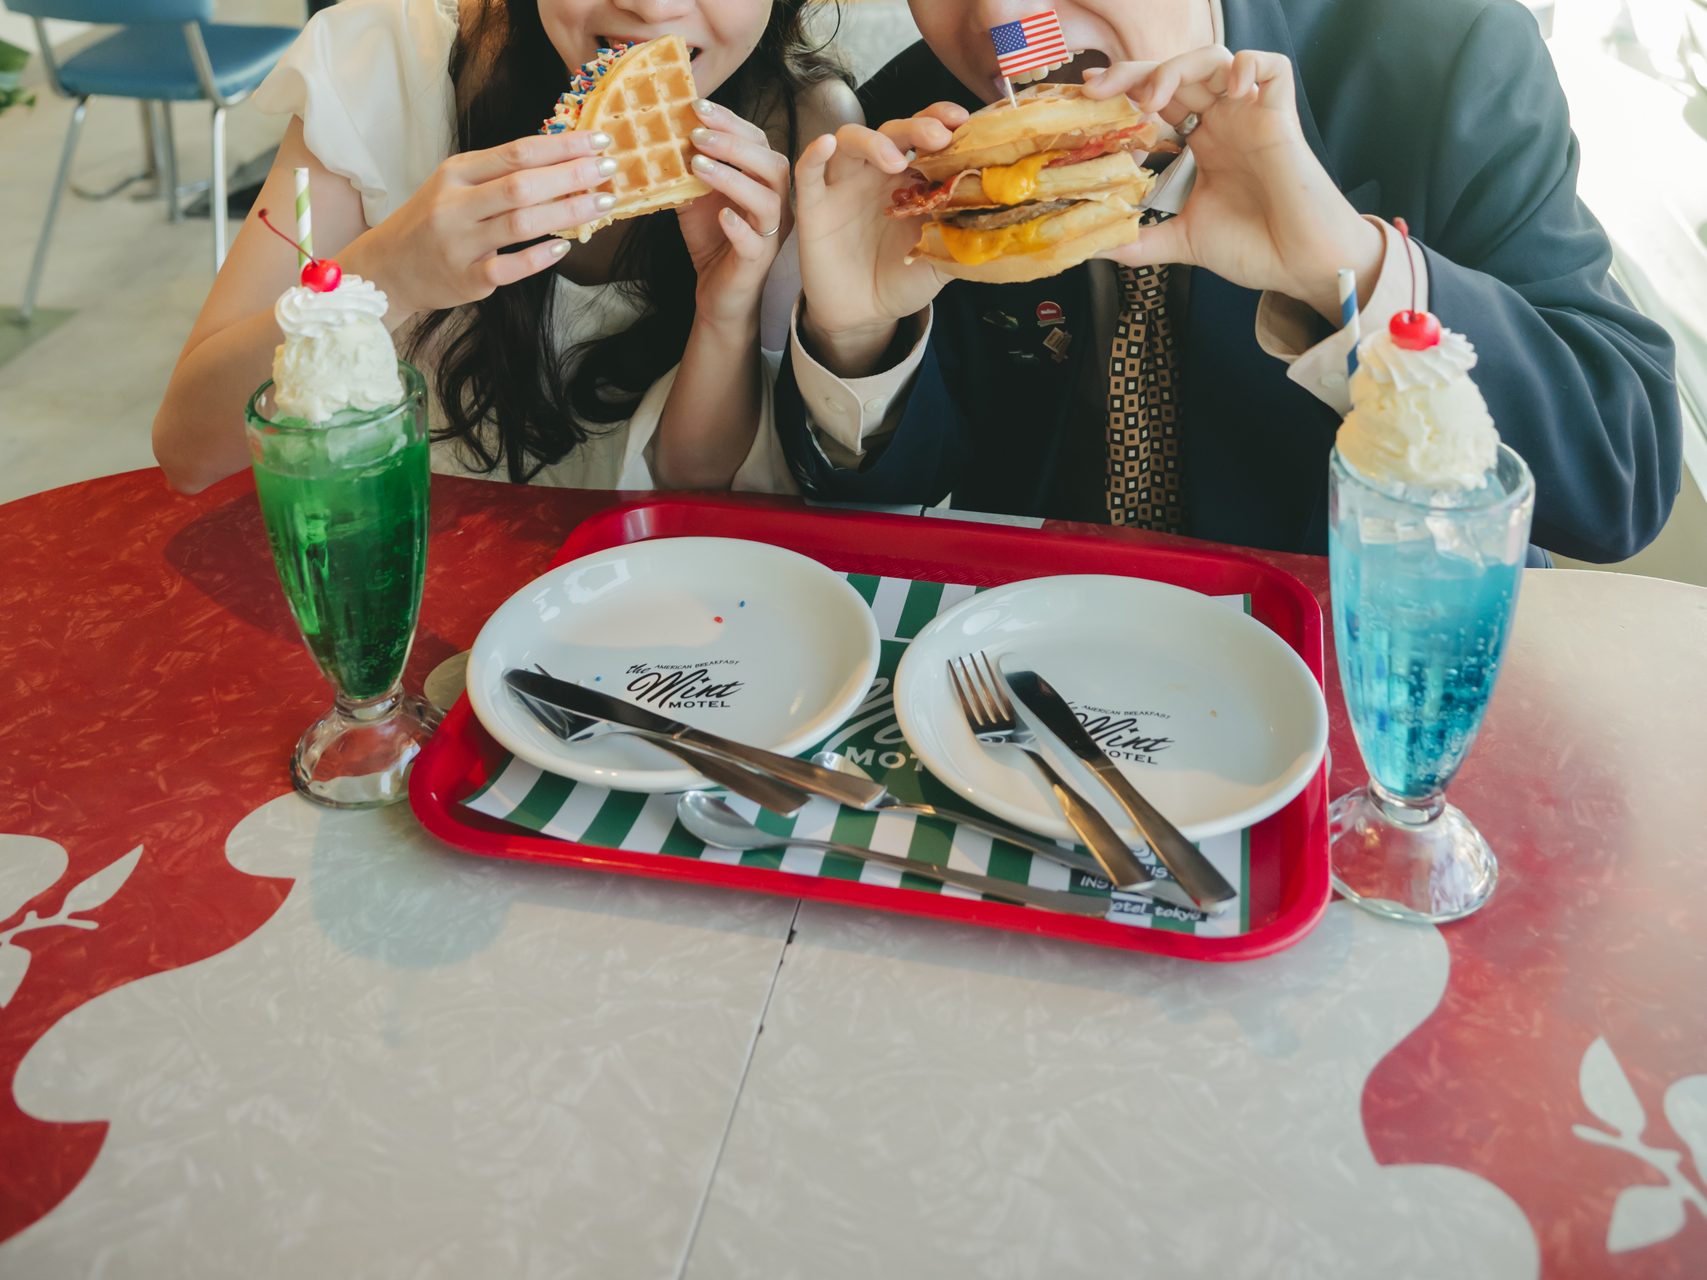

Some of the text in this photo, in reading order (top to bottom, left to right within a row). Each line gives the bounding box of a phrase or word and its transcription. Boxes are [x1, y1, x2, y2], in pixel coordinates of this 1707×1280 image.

[694, 660, 740, 669] BREAKFAST
[626, 668, 745, 709] Mint
[668, 700, 731, 709] MOTEL
[1081, 705, 1121, 715] AMERICAN
[1123, 710, 1171, 719] BREAKFAST
[844, 746, 924, 772] MOT
[1102, 749, 1159, 765] OTEL
